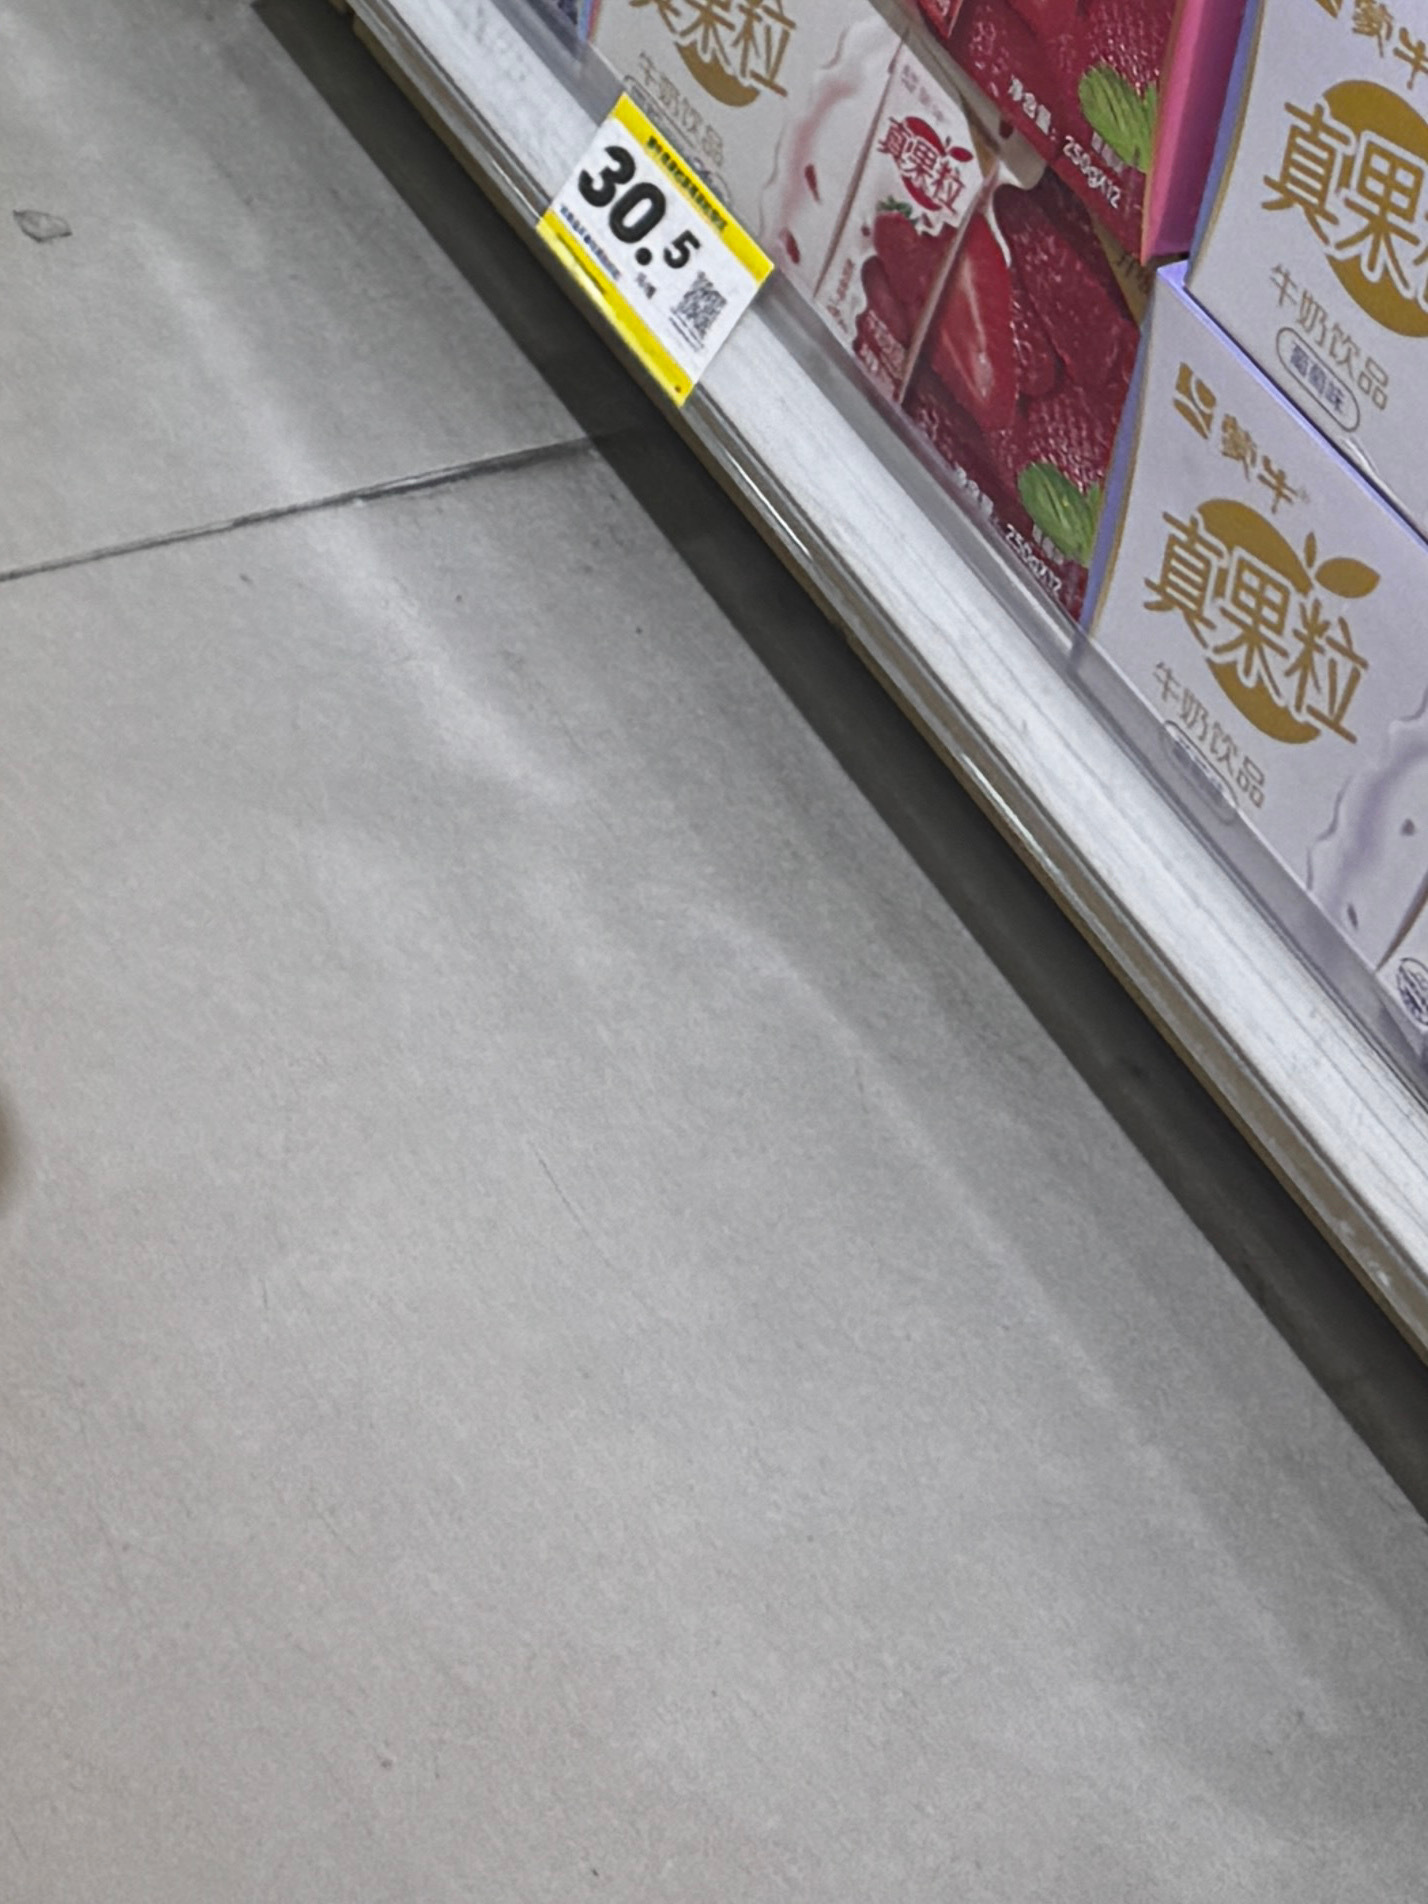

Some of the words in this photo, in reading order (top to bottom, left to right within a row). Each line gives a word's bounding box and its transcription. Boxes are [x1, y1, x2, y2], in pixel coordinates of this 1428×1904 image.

[578, 145, 701, 266] 30.5
[1261, 99, 1428, 282] 真果
[1270, 263, 1390, 410] 牛奶饮品
[1221, 413, 1298, 513] 蒙牛
[1144, 512, 1368, 744] 真果粒
[1153, 660, 1266, 808] 牛奶饮品
